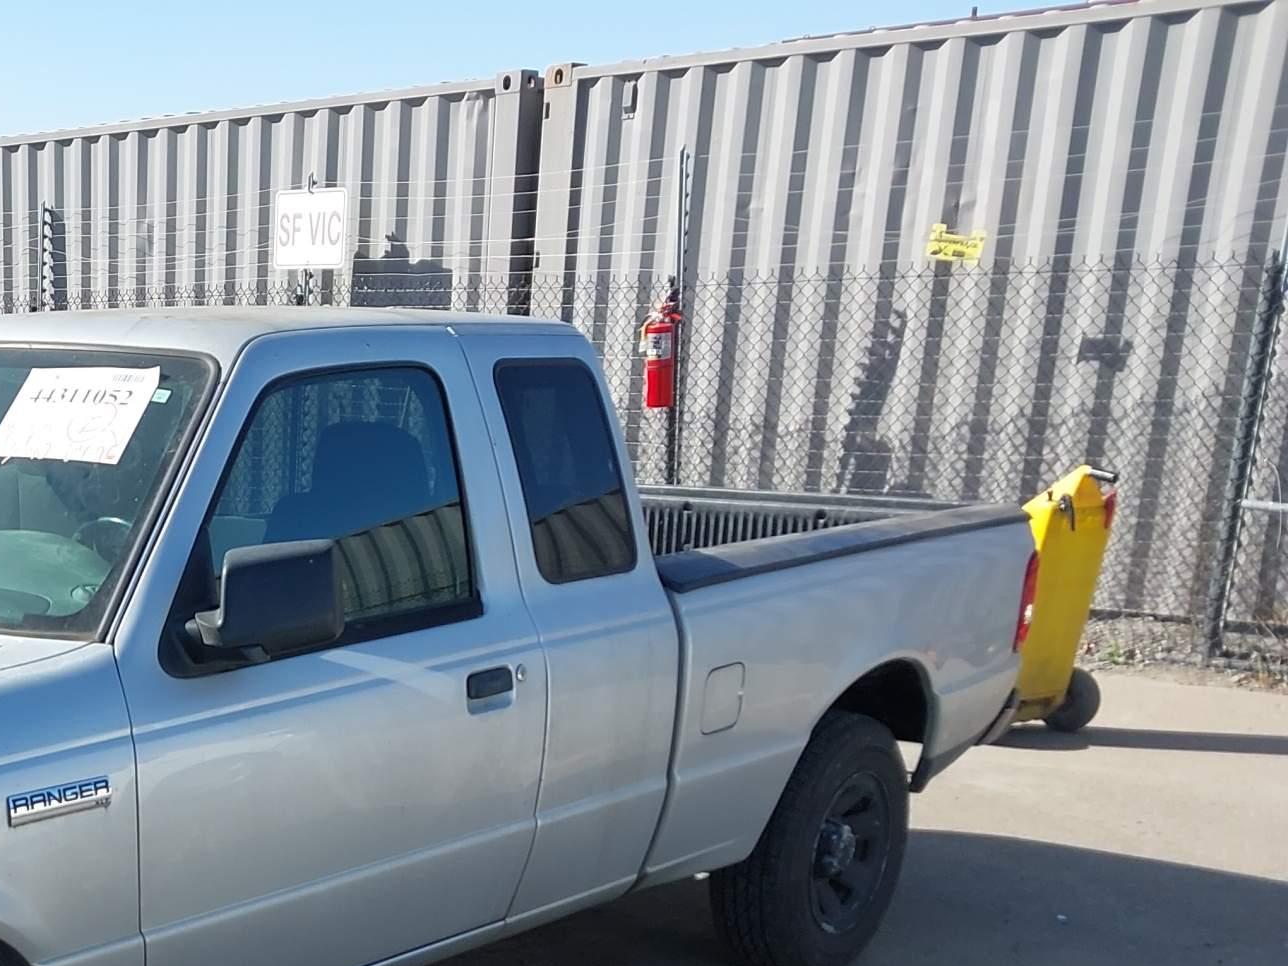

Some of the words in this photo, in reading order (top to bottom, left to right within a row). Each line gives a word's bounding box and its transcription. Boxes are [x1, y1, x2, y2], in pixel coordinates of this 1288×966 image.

[279, 213, 302, 247] SF
[309, 211, 341, 246] VIC
[30, 388, 133, 406] 44311052
[11, 779, 110, 814] RANGER
